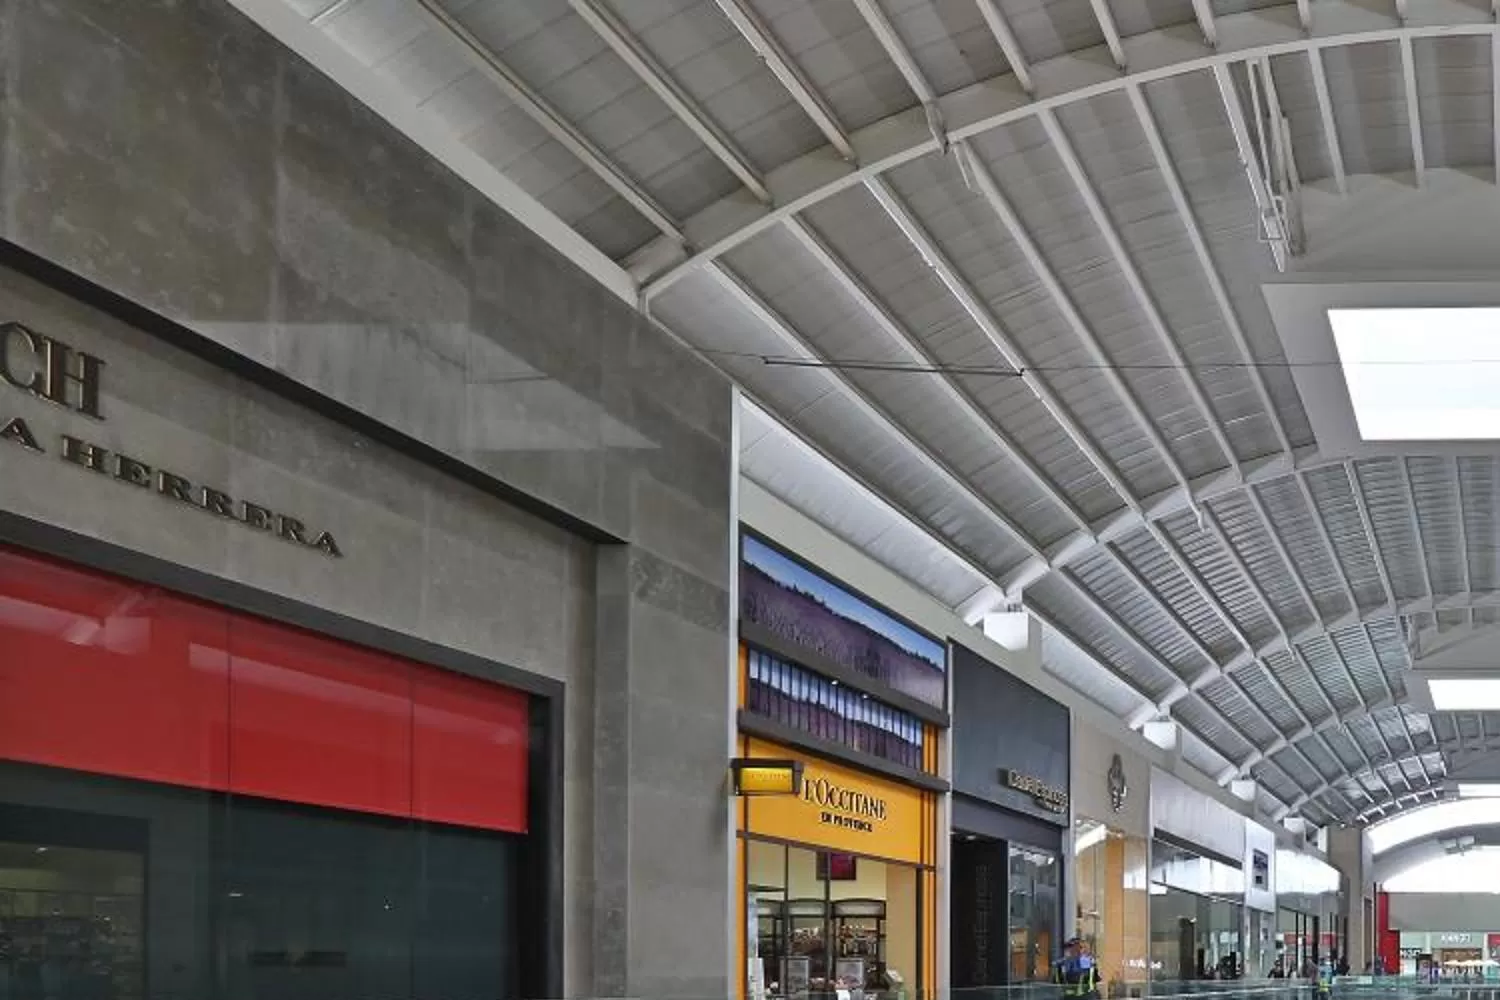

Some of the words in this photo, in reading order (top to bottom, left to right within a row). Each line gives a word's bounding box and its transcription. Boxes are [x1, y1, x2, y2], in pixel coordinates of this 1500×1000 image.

[0, 321, 105, 421] CH
[60, 434, 344, 558] HERRERA
[803, 777, 887, 821] L'OCCITANE
